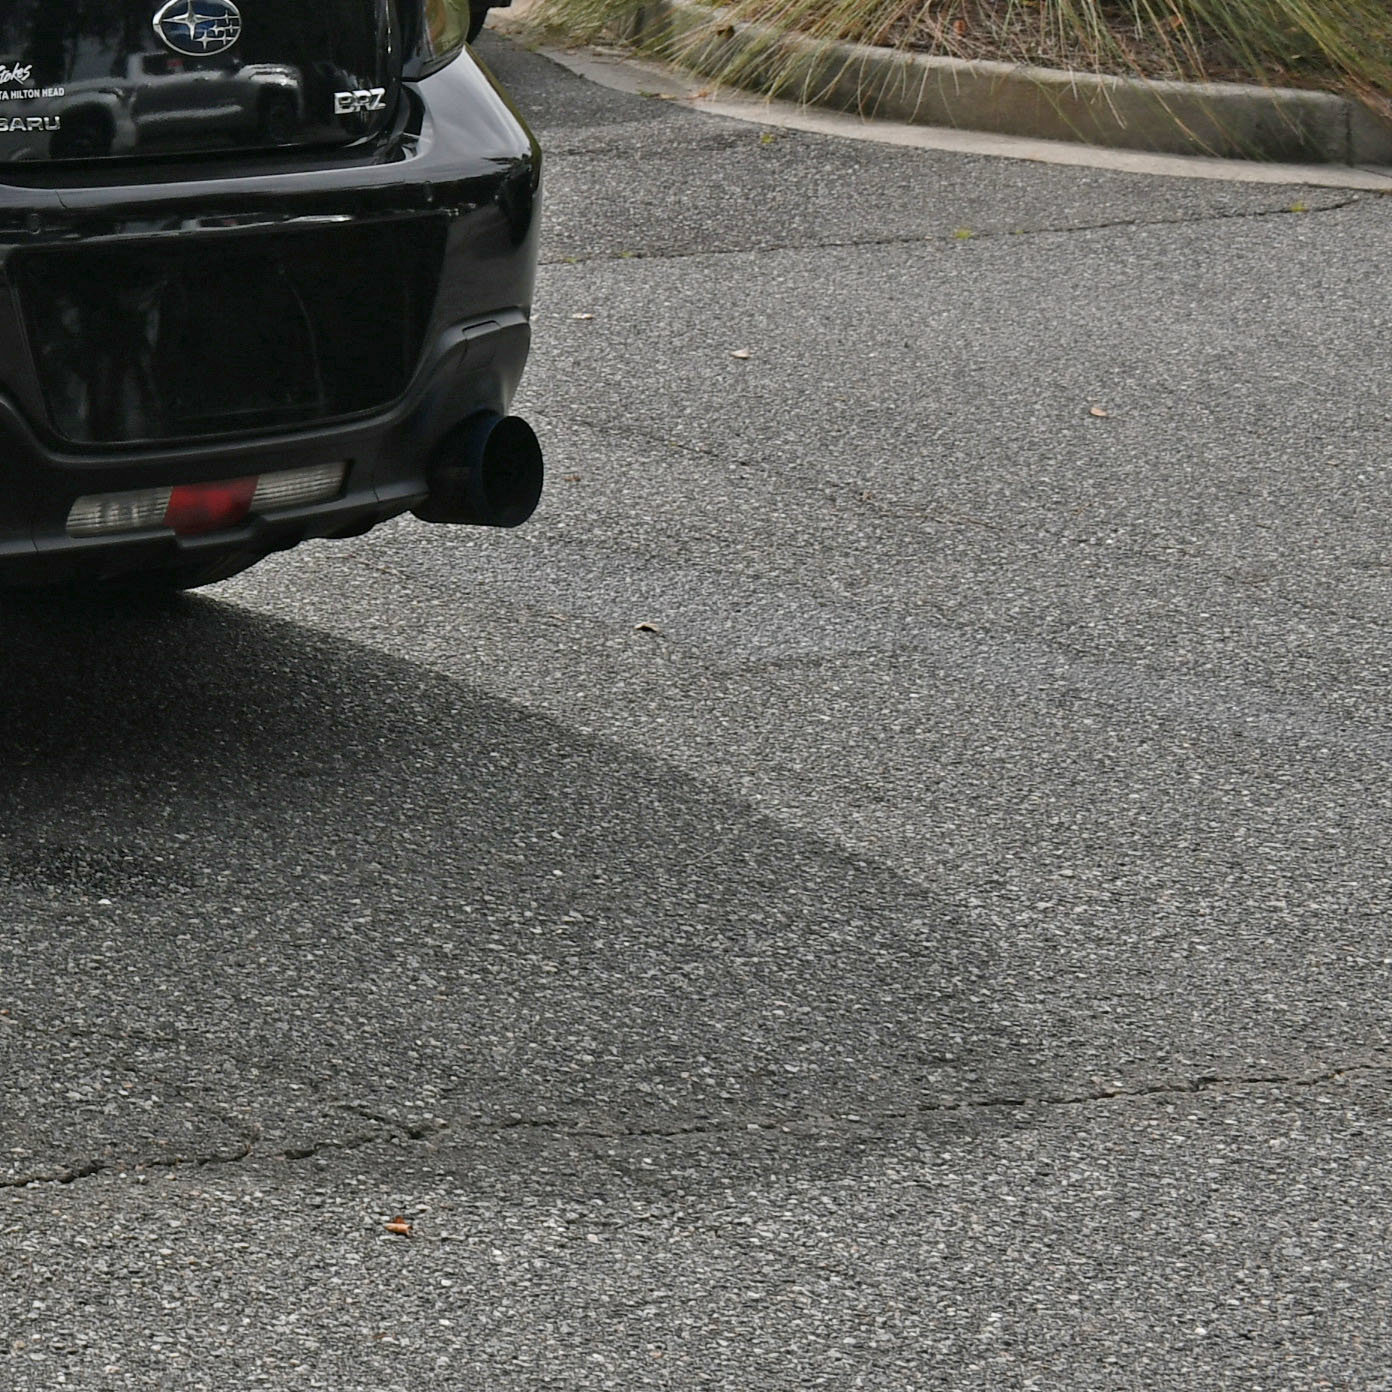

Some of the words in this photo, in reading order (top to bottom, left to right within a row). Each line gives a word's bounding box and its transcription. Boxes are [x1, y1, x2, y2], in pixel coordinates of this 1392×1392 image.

[10, 88, 40, 99] HILTON
[42, 87, 65, 97] HEAD
[334, 88, 386, 115] BRZ
